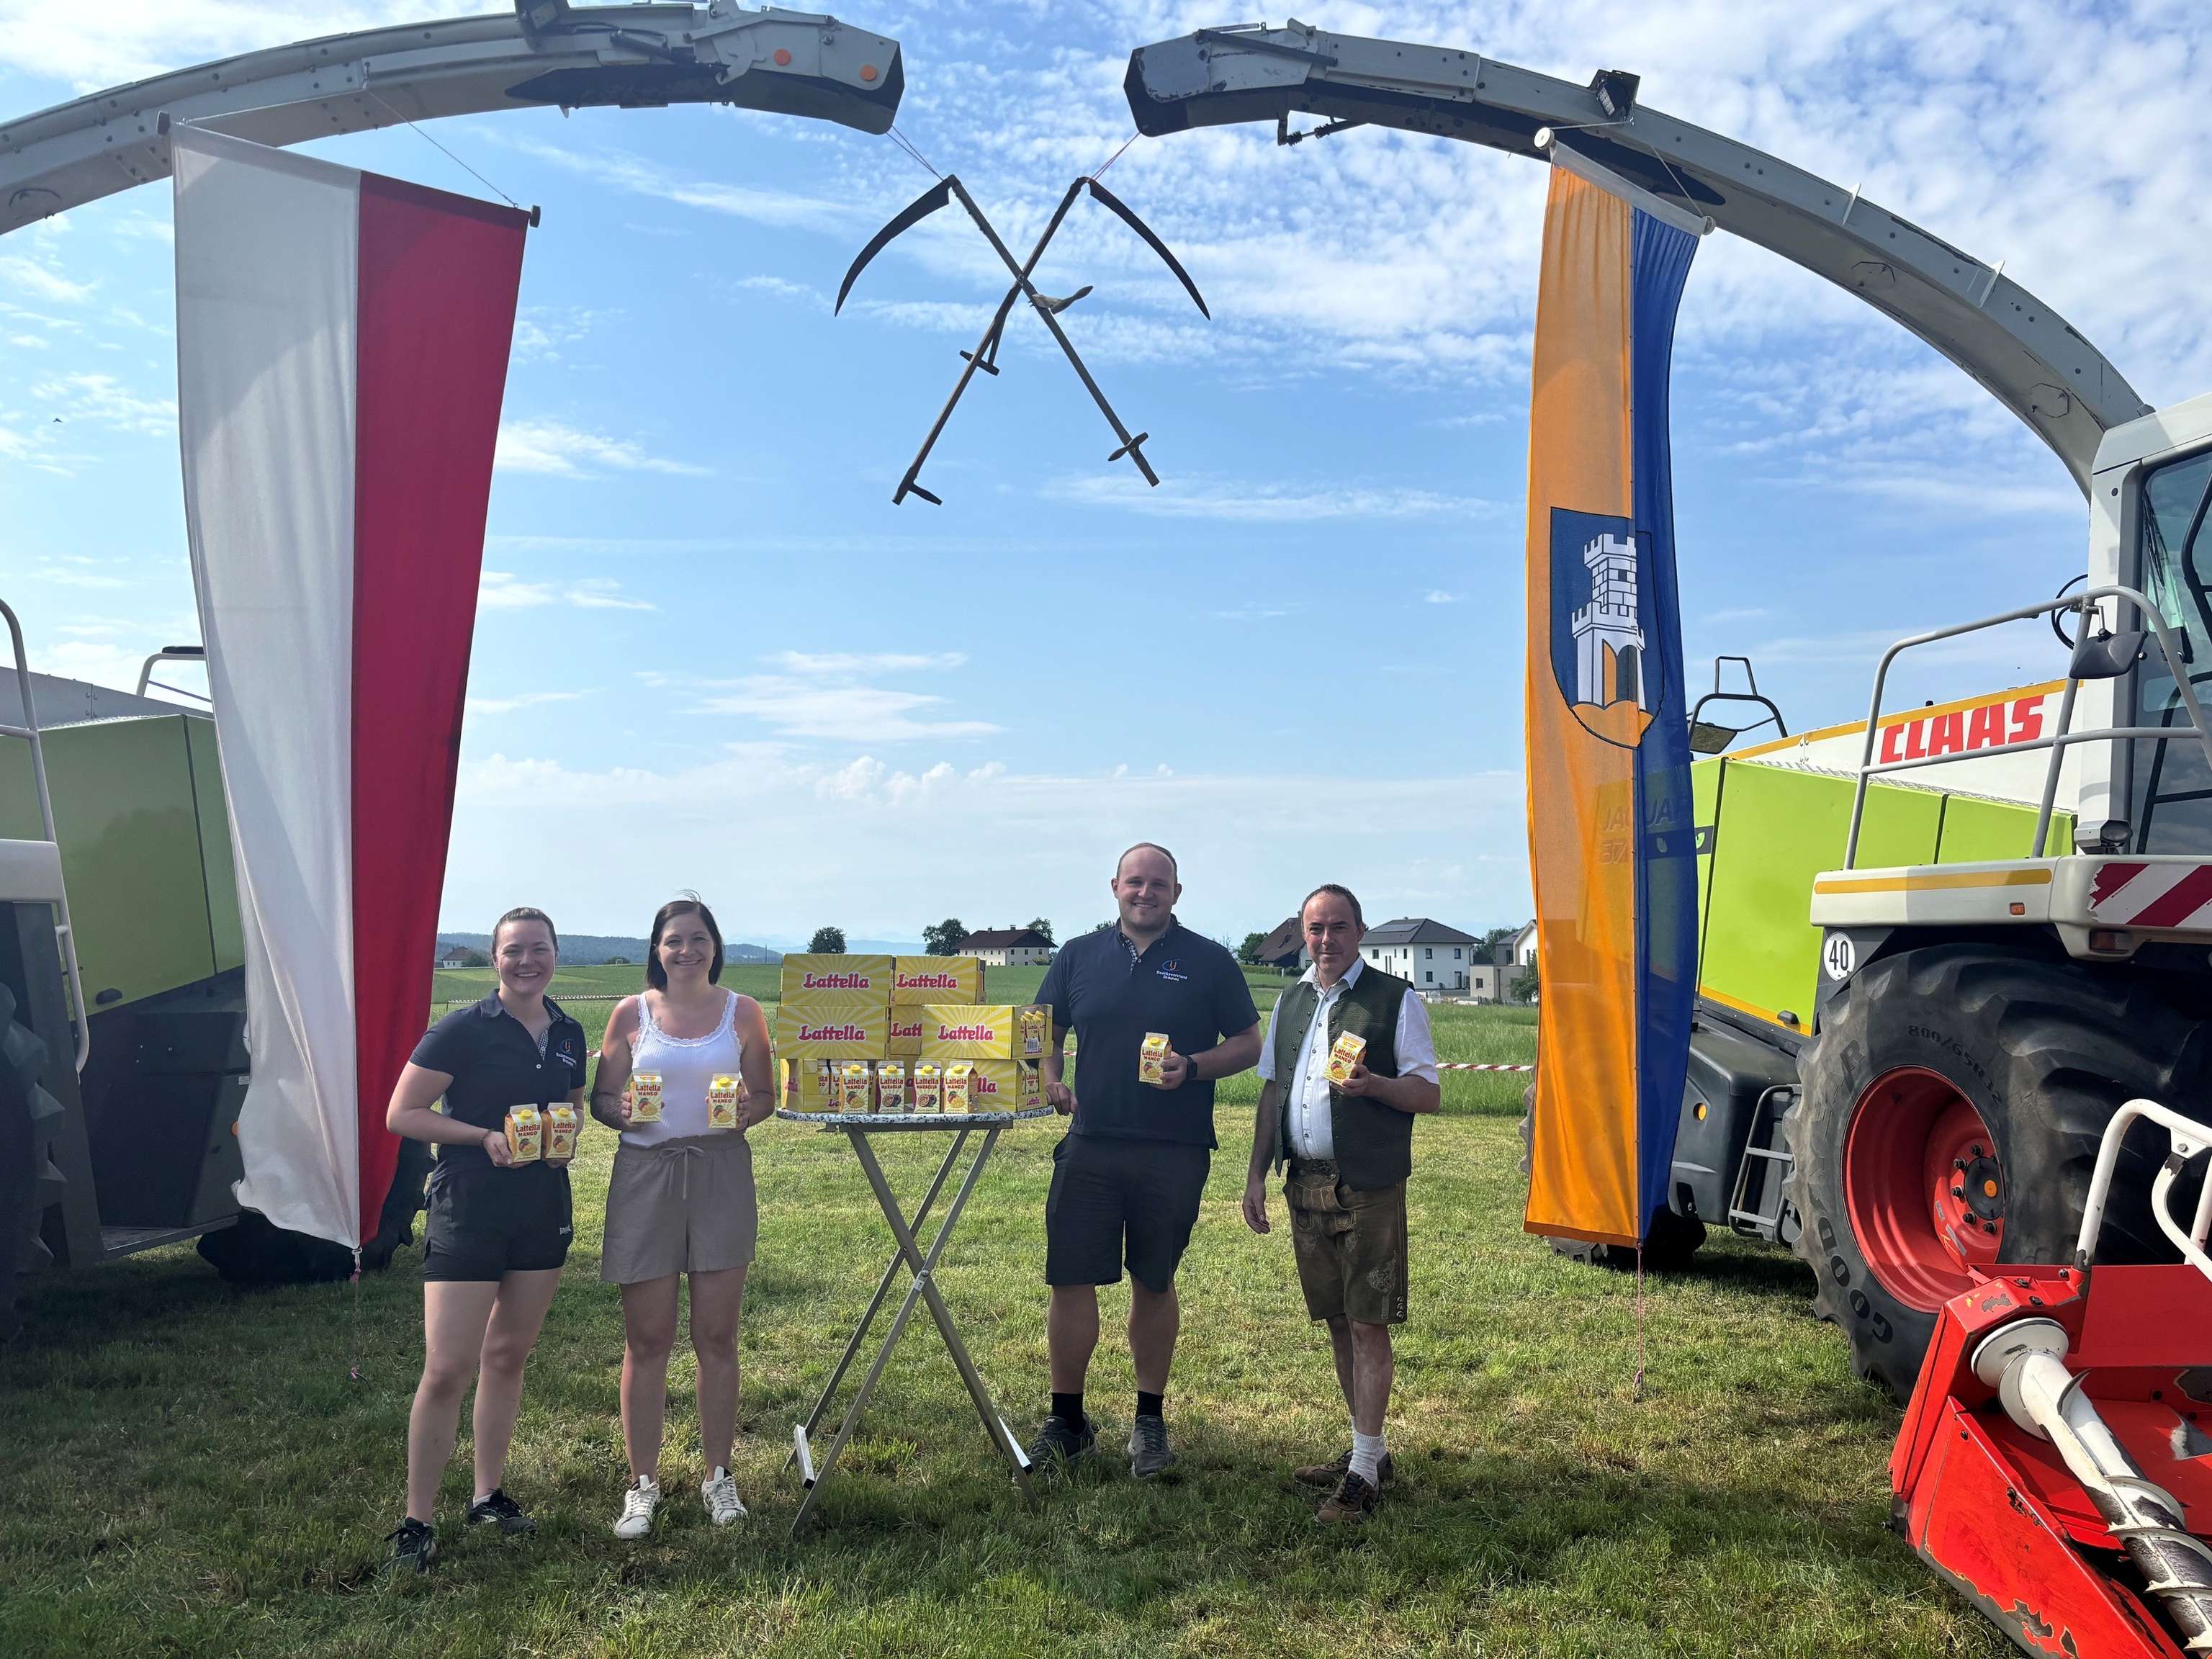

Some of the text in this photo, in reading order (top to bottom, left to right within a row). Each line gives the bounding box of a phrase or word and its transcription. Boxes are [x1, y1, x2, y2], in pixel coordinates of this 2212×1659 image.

[1880, 695, 2044, 764] CLAAS
[1829, 940, 1849, 971] 40
[803, 973, 869, 989] Lattella
[896, 974, 957, 989] Lattella
[798, 1025, 866, 1040] Lattella
[938, 1025, 994, 1040] Lattella
[1141, 1048, 1163, 1057] Lattella
[1334, 1046, 1356, 1061] Lattella
[1334, 1053, 1352, 1064] MANGO
[516, 1124, 541, 1133] Lattella
